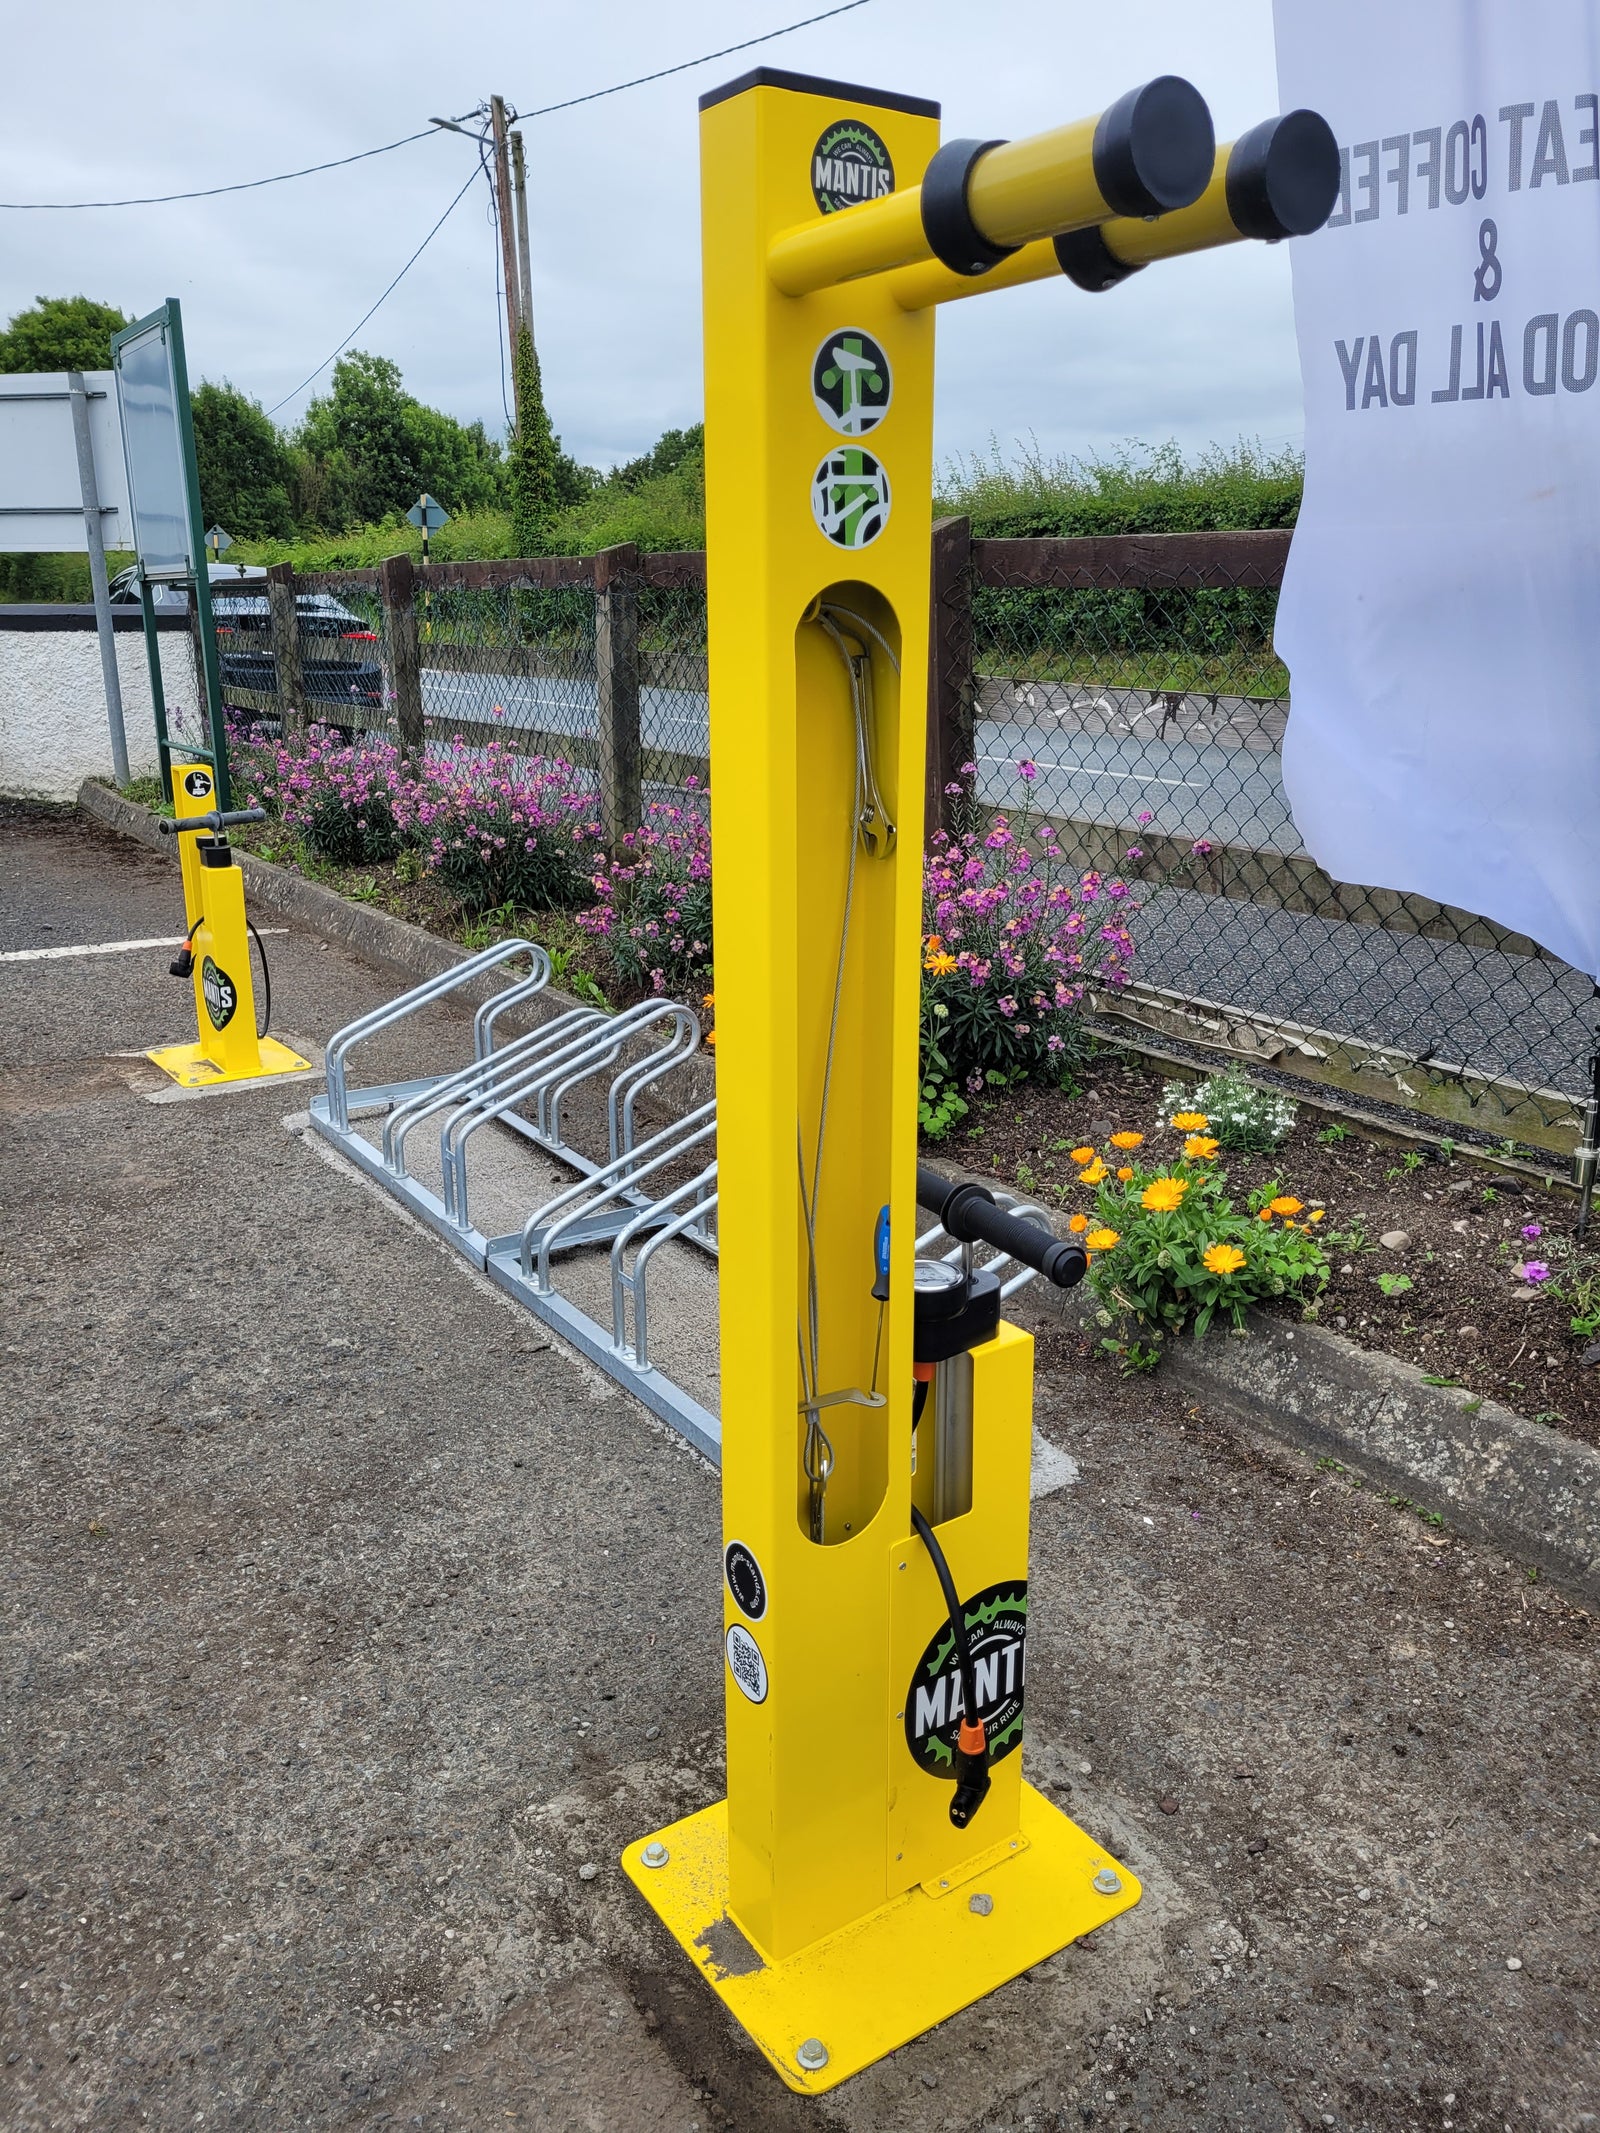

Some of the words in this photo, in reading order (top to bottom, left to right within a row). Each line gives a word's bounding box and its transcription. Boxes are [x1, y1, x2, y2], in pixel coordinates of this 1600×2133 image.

[855, 143, 874, 164] ALWAYS
[815, 156, 890, 199] MANTIS
[993, 1619, 1026, 1636] ALWAYS
[999, 1699, 1021, 1725] RIDE
